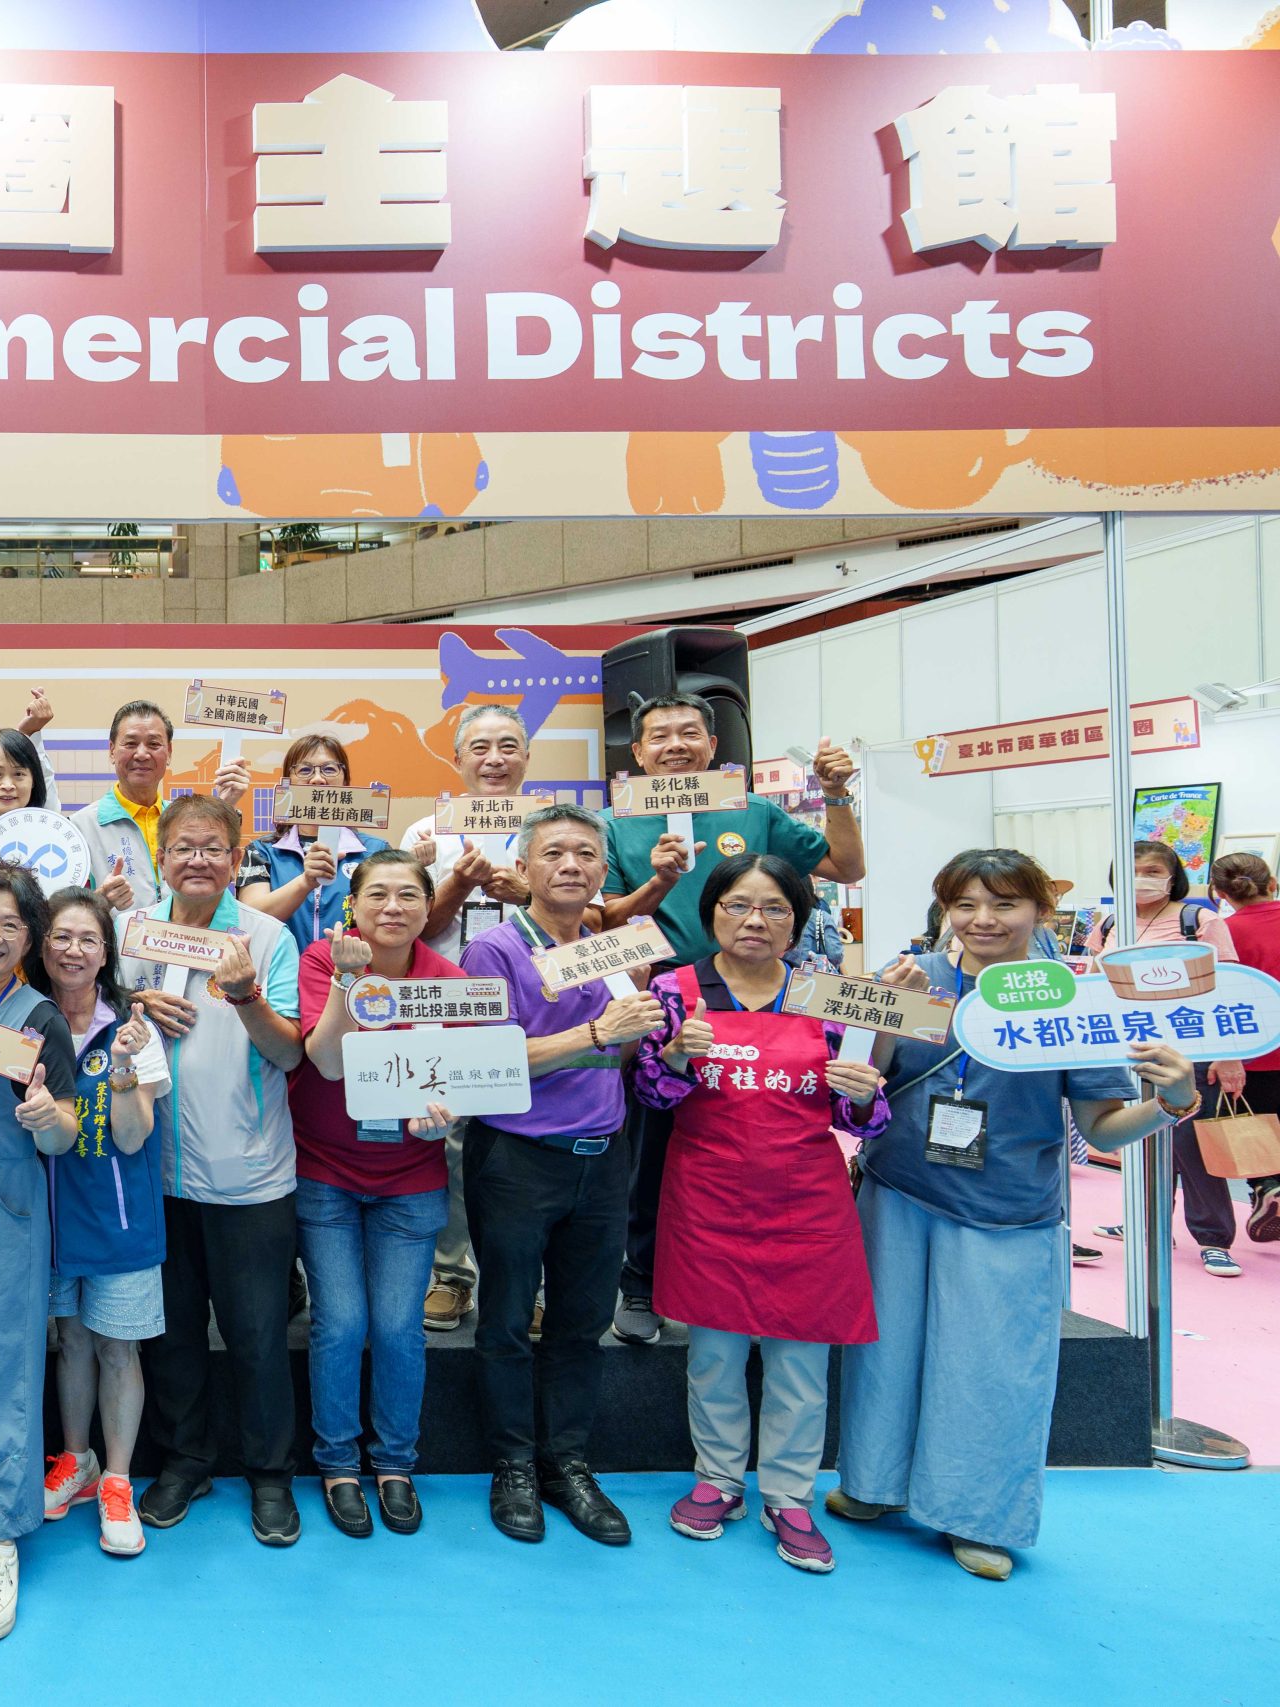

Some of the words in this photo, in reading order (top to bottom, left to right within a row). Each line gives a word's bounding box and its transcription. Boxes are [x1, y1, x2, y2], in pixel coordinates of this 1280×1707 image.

[485, 281, 1094, 380] Districts
[216, 694, 259, 710] 中華民國
[203, 707, 268, 726] 全國商圈總會
[958, 718, 1154, 760] 臺北市萬華街區圈
[651, 777, 701, 793] 彰化縣
[311, 790, 353, 805] 新竹縣
[644, 793, 710, 810] 田中商圈
[1150, 794, 1168, 802] Carte
[1179, 791, 1202, 799] France
[289, 806, 374, 823] 北埔老街商圈
[470, 800, 514, 813] 新北市
[463, 815, 522, 830] 坪林商圈
[167, 931, 203, 943] TAIWAN
[152, 938, 186, 951] YOUR
[188, 944, 215, 956] WAY
[574, 935, 621, 959] 臺北市
[559, 942, 656, 982] 萬華街區商圈
[1002, 970, 1050, 990] 北投
[398, 985, 442, 1000] 臺北市
[838, 982, 899, 1007] 新北市
[996, 989, 1062, 1005] BEITOU
[399, 1001, 503, 1018] 新北投溫泉商圈
[823, 998, 904, 1029] 深坑商圈
[993, 1003, 1261, 1050] 水都溫泉會館
[357, 1071, 379, 1083] 北投
[449, 1067, 521, 1081] 溫泉會館
[701, 1061, 818, 1095] 寶桂的店
